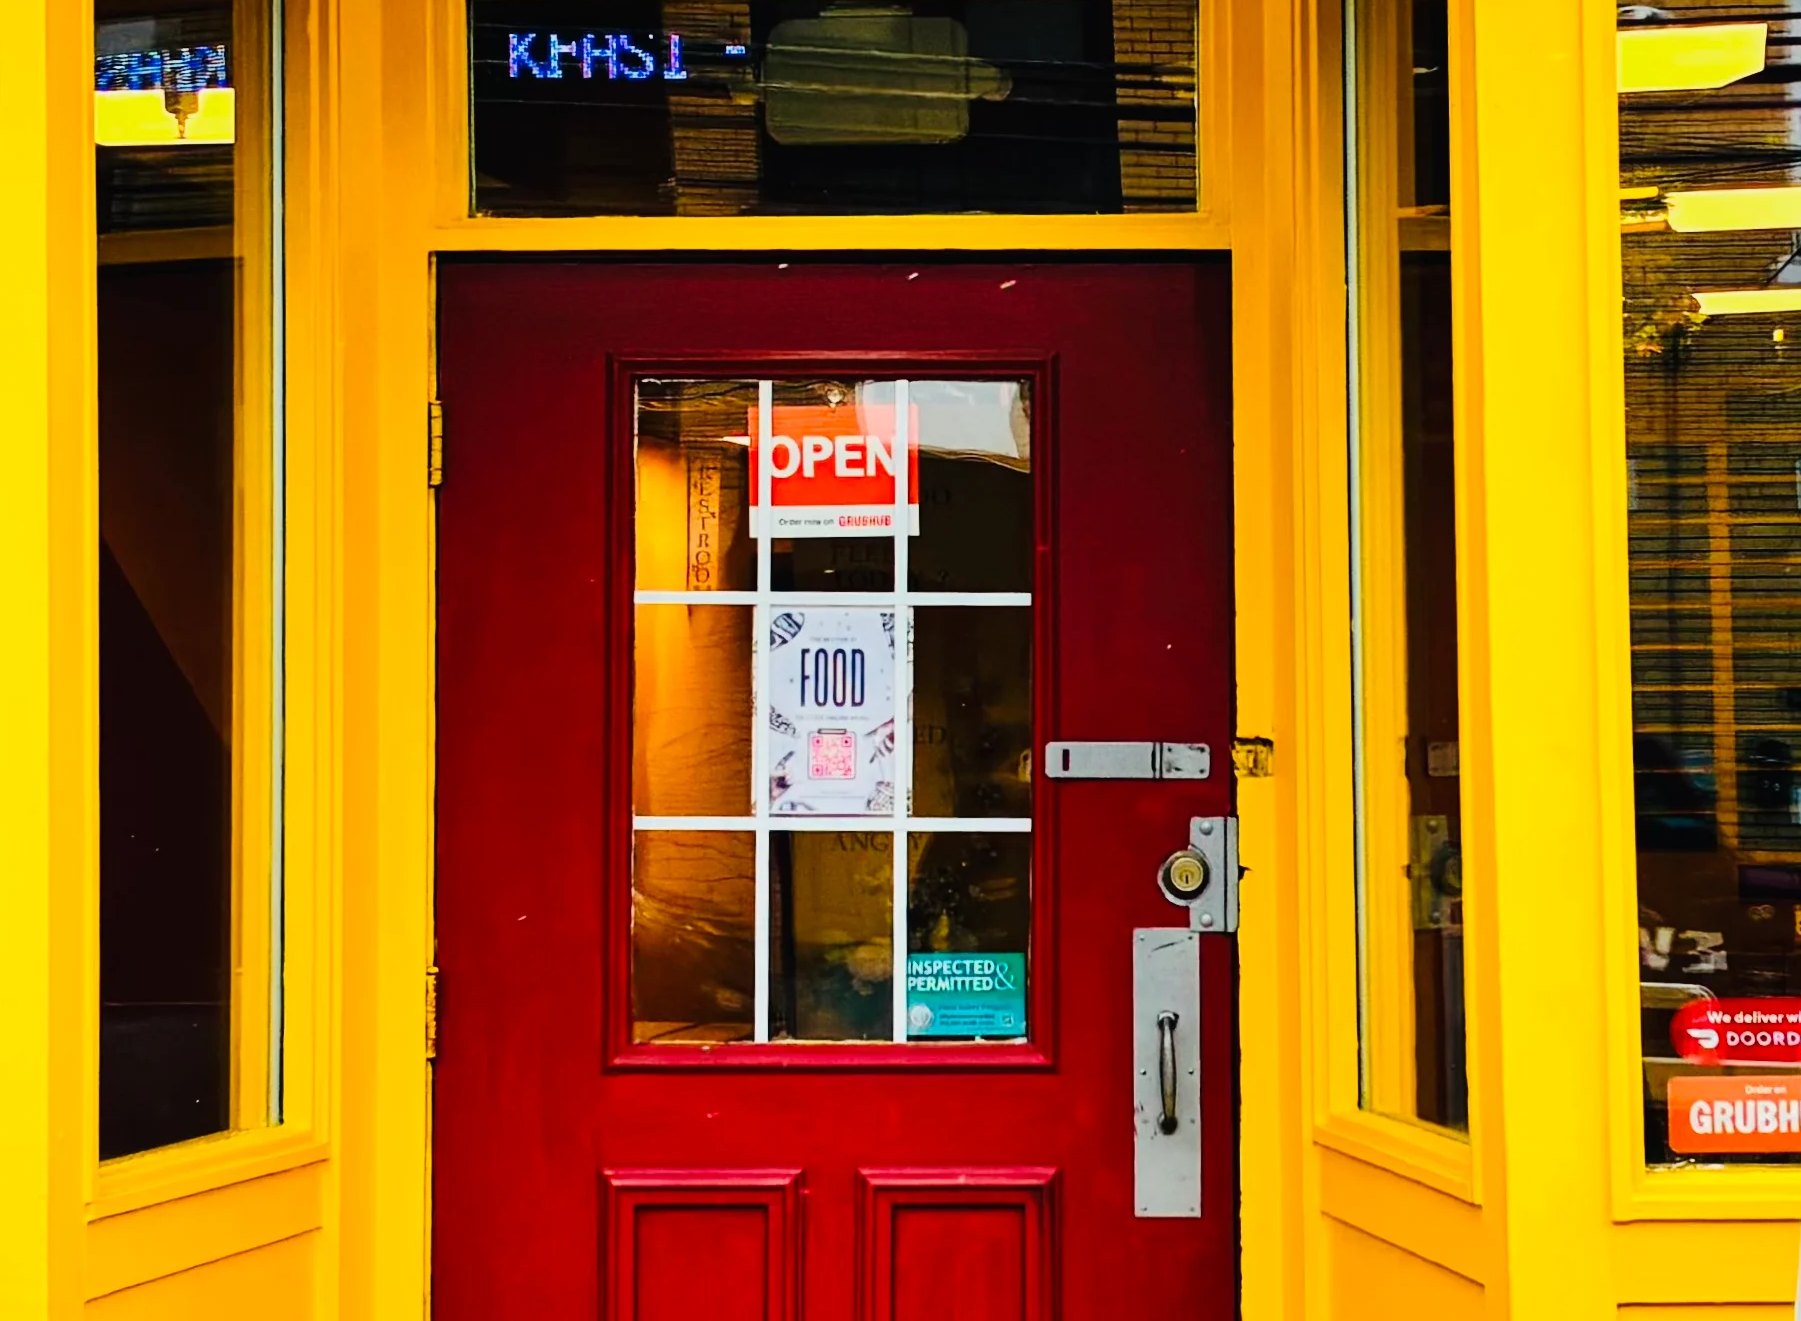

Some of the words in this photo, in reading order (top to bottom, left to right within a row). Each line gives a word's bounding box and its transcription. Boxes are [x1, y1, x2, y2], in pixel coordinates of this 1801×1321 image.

[770, 435, 897, 479] OPEN
[695, 465, 718, 590] RESTROO
[800, 647, 865, 707] FOOD
[835, 833, 925, 854] ANGY
[907, 959, 995, 975] INSPECTED
[907, 975, 994, 992] PERMITTED
[1707, 1010, 1725, 1024] We
[1727, 1010, 1783, 1025] deliver
[1745, 1084, 1772, 1095] Order
